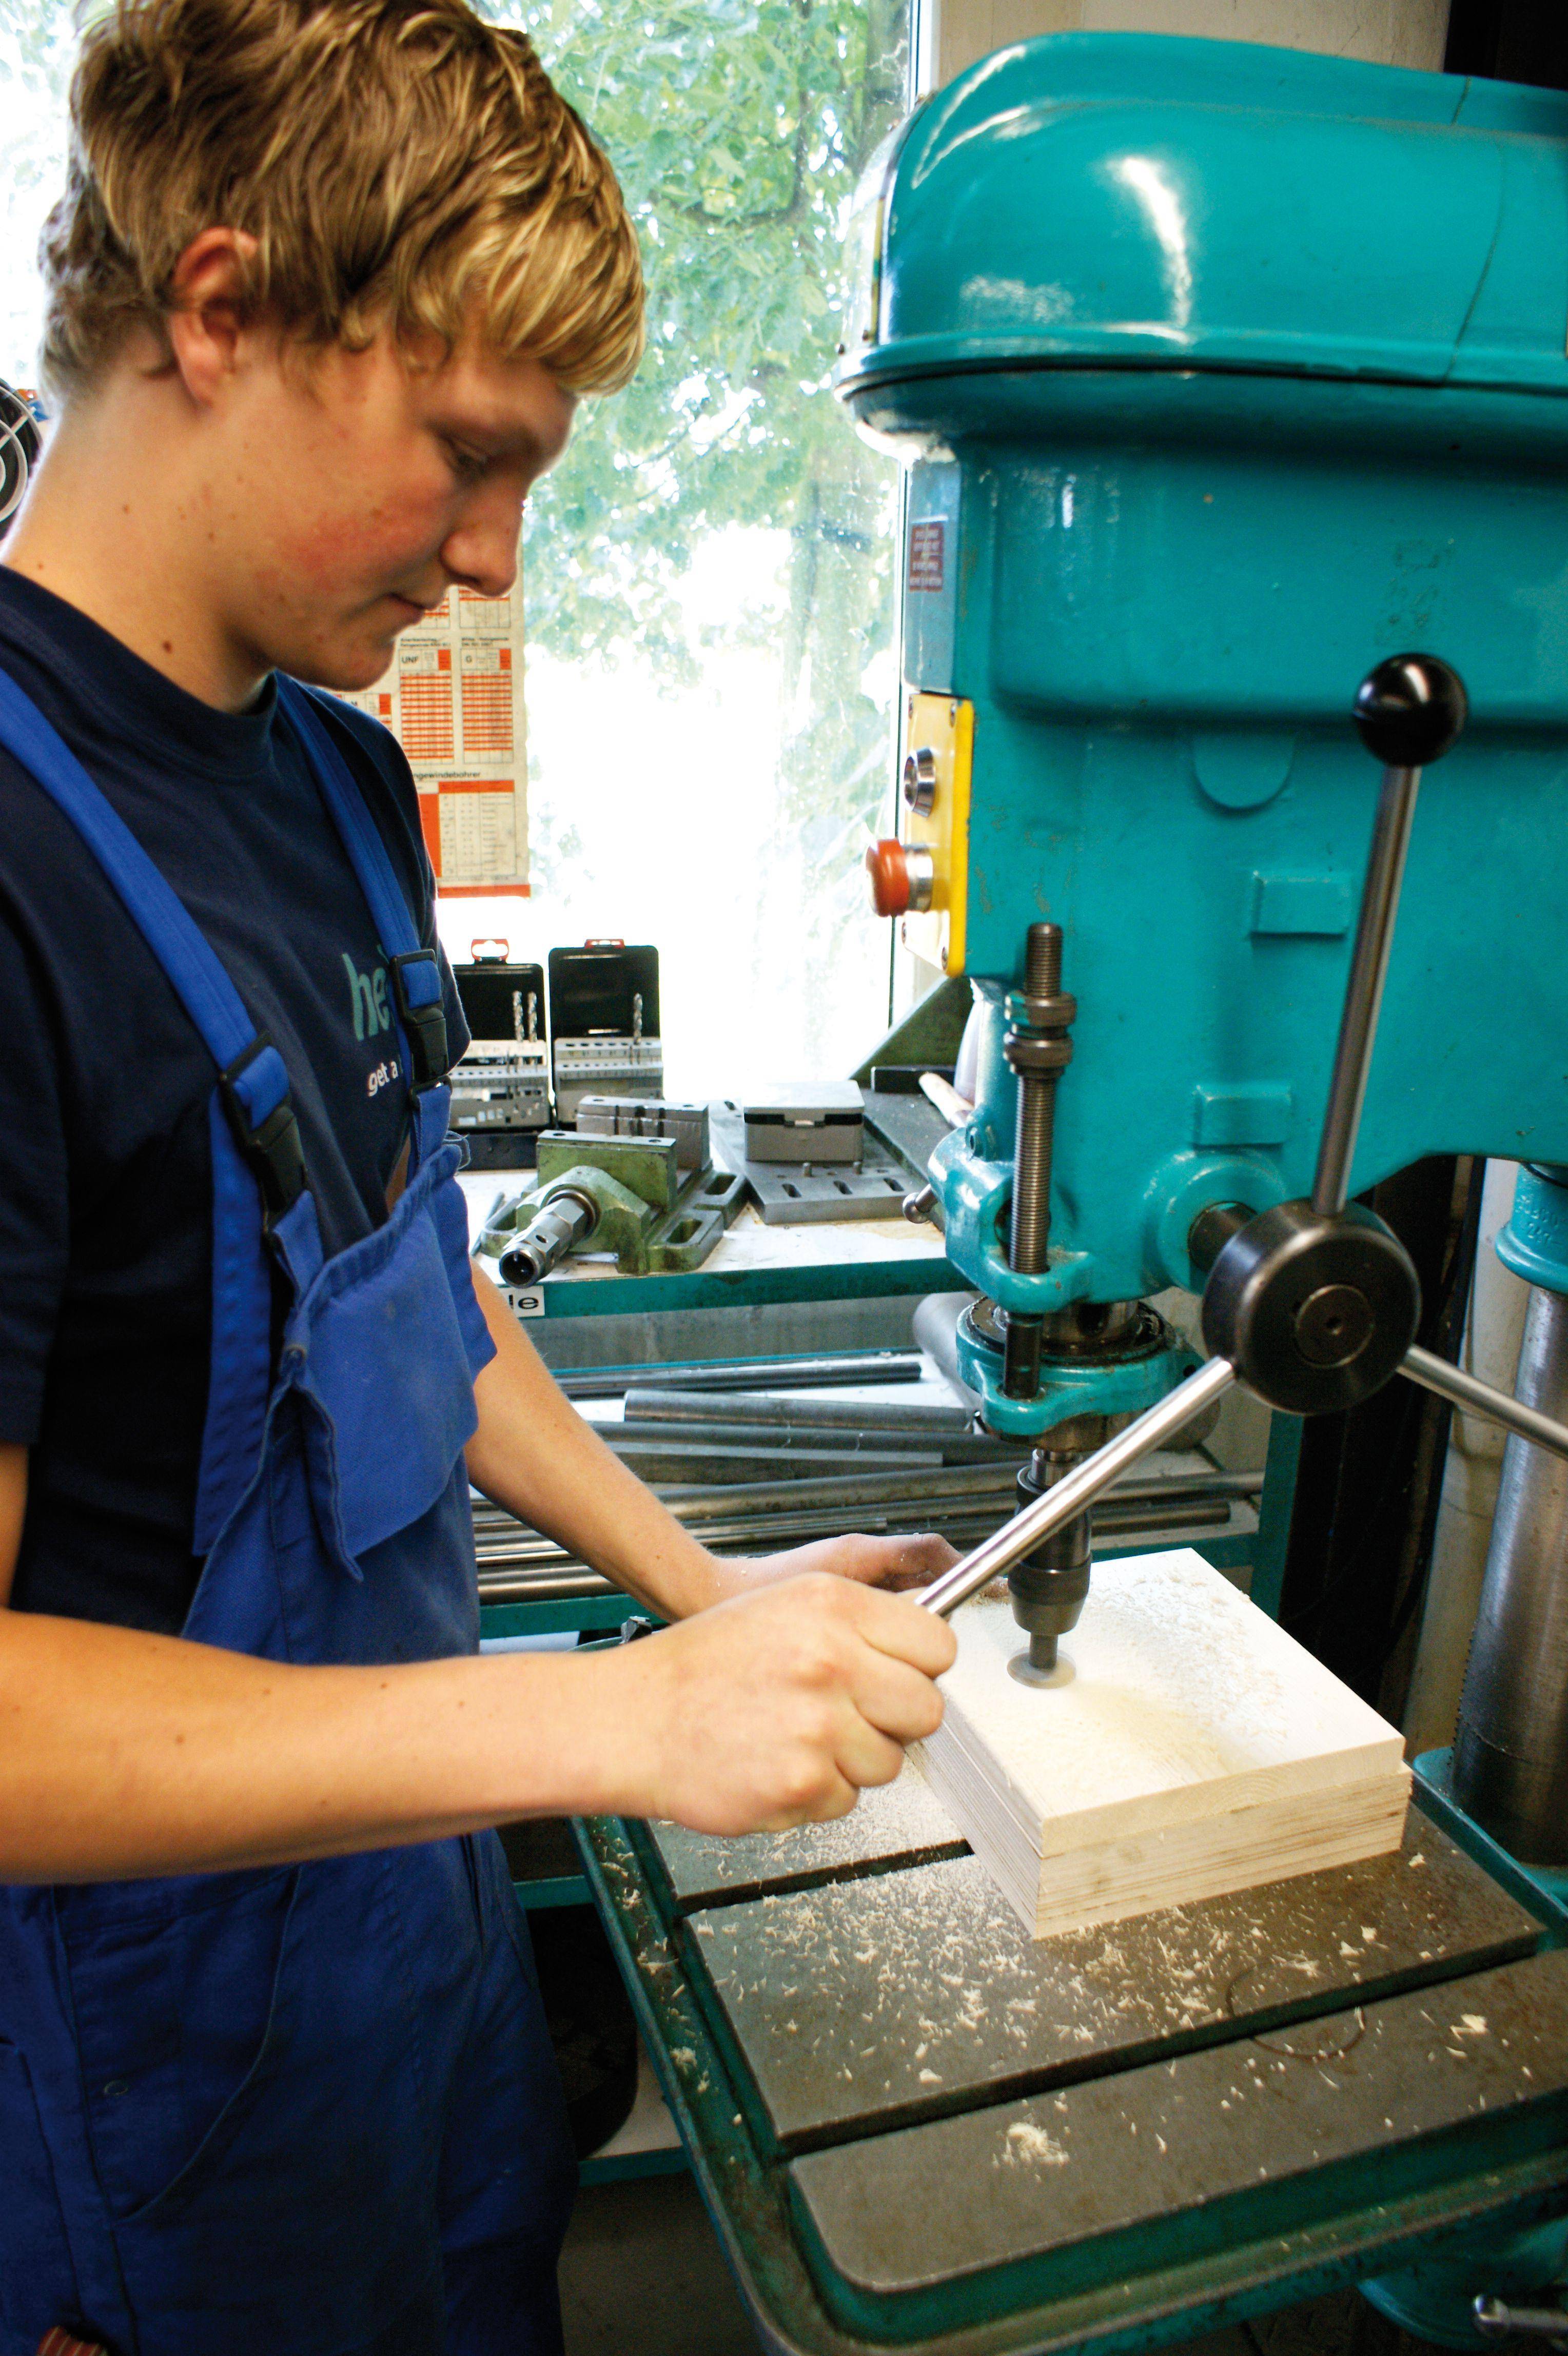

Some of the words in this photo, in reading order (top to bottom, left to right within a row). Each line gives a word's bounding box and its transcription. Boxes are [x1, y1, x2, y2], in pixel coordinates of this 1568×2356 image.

[342, 945, 395, 1042] he
[367, 1062, 389, 1097] get
[390, 1060, 399, 1079] a
